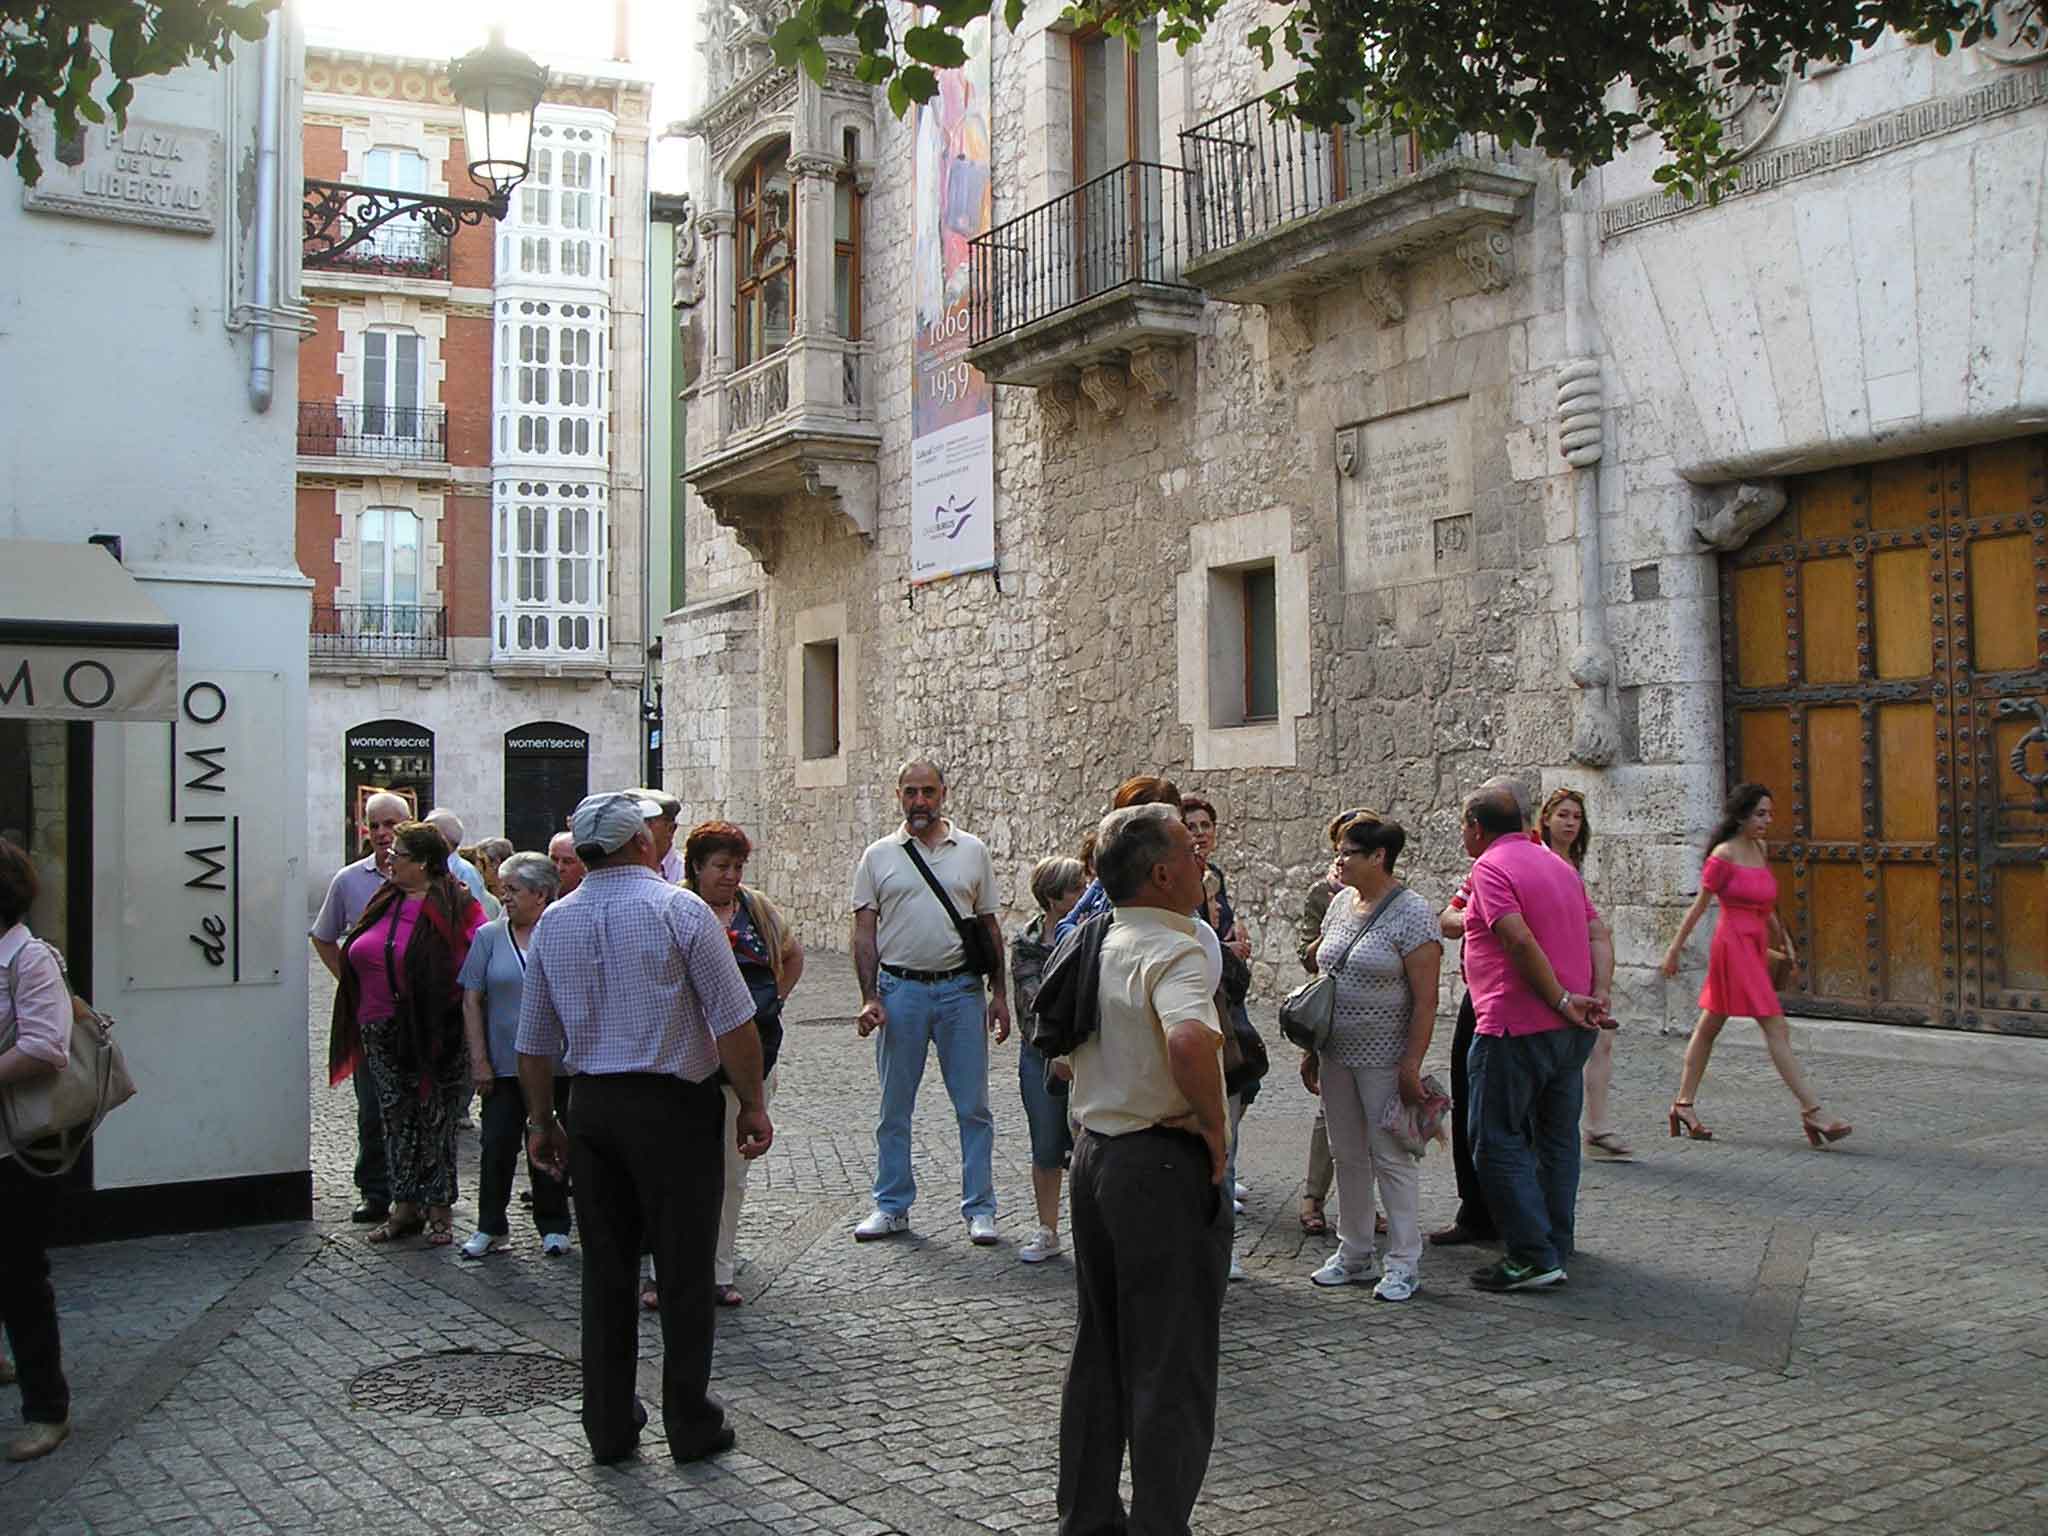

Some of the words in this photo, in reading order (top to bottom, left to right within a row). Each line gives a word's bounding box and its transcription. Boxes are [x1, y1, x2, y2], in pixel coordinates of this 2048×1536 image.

[105, 124, 183, 161] PLAZA
[117, 156, 140, 174] DE
[150, 159, 171, 178] LA
[82, 168, 202, 211] LIBERTAD
[930, 361, 969, 408] 1959
[350, 737, 431, 748] women'secret
[184, 681, 227, 891] MIMO
[189, 914, 227, 967] de
